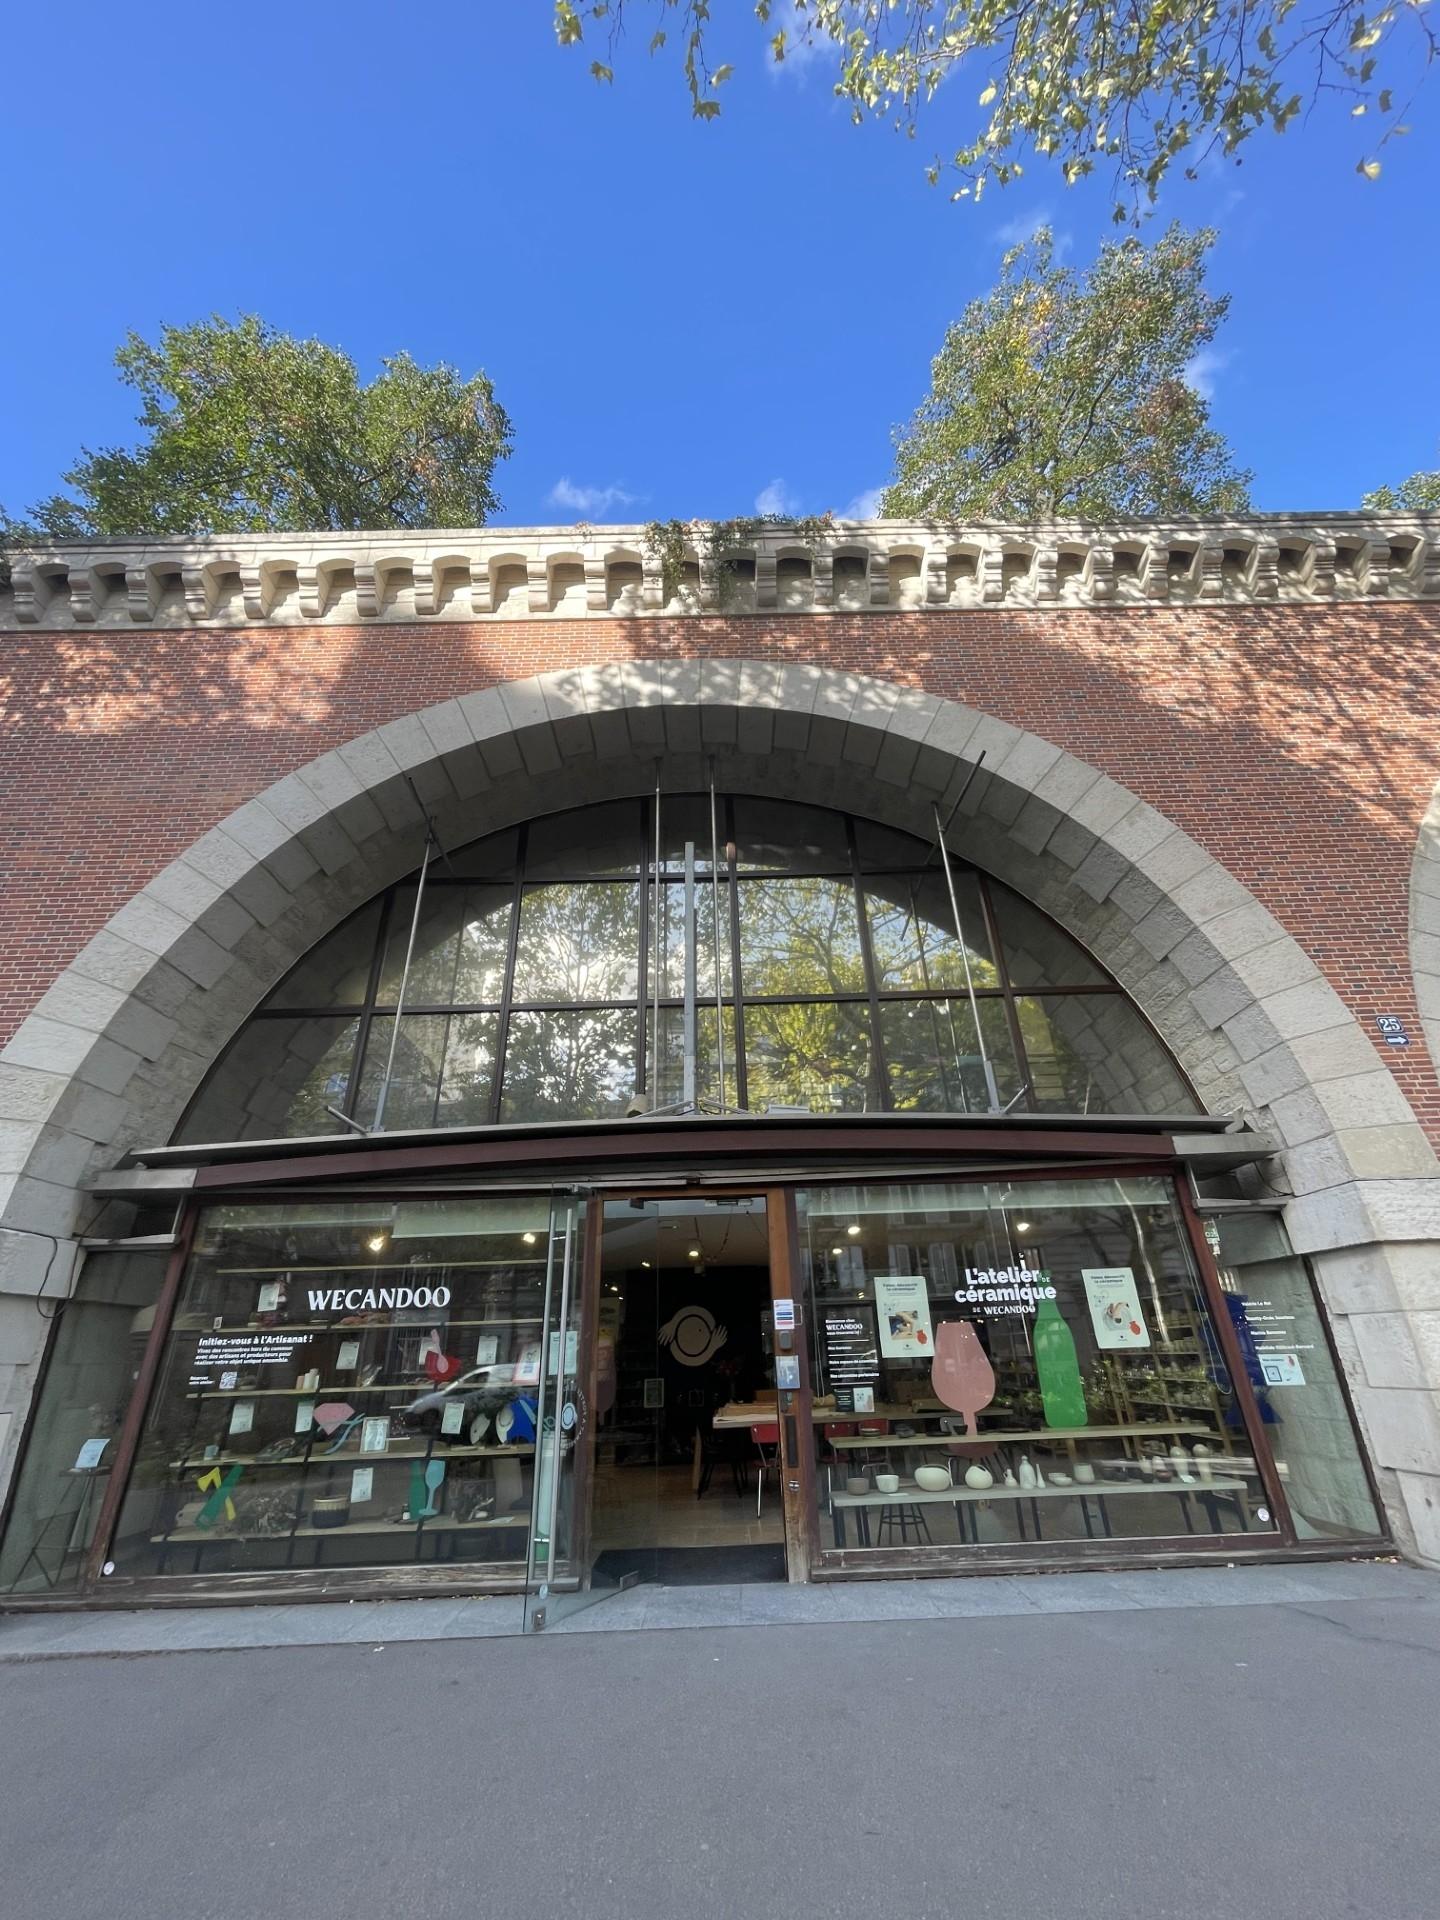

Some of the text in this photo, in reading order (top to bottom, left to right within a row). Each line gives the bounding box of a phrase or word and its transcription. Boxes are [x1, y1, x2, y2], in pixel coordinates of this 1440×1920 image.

[1379, 1018, 1401, 1031] 25
[964, 1266, 1040, 1285] L'atelier
[307, 1286, 451, 1311] WECANDOO
[954, 1284, 1057, 1306] céramique
[983, 1305, 1036, 1315] WECANDOO
[825, 1323, 863, 1331] WECANDOO
[198, 1337, 252, 1346] Initiez-vous
[253, 1335, 259, 1344] à
[260, 1334, 308, 1344] l'Artisanat
